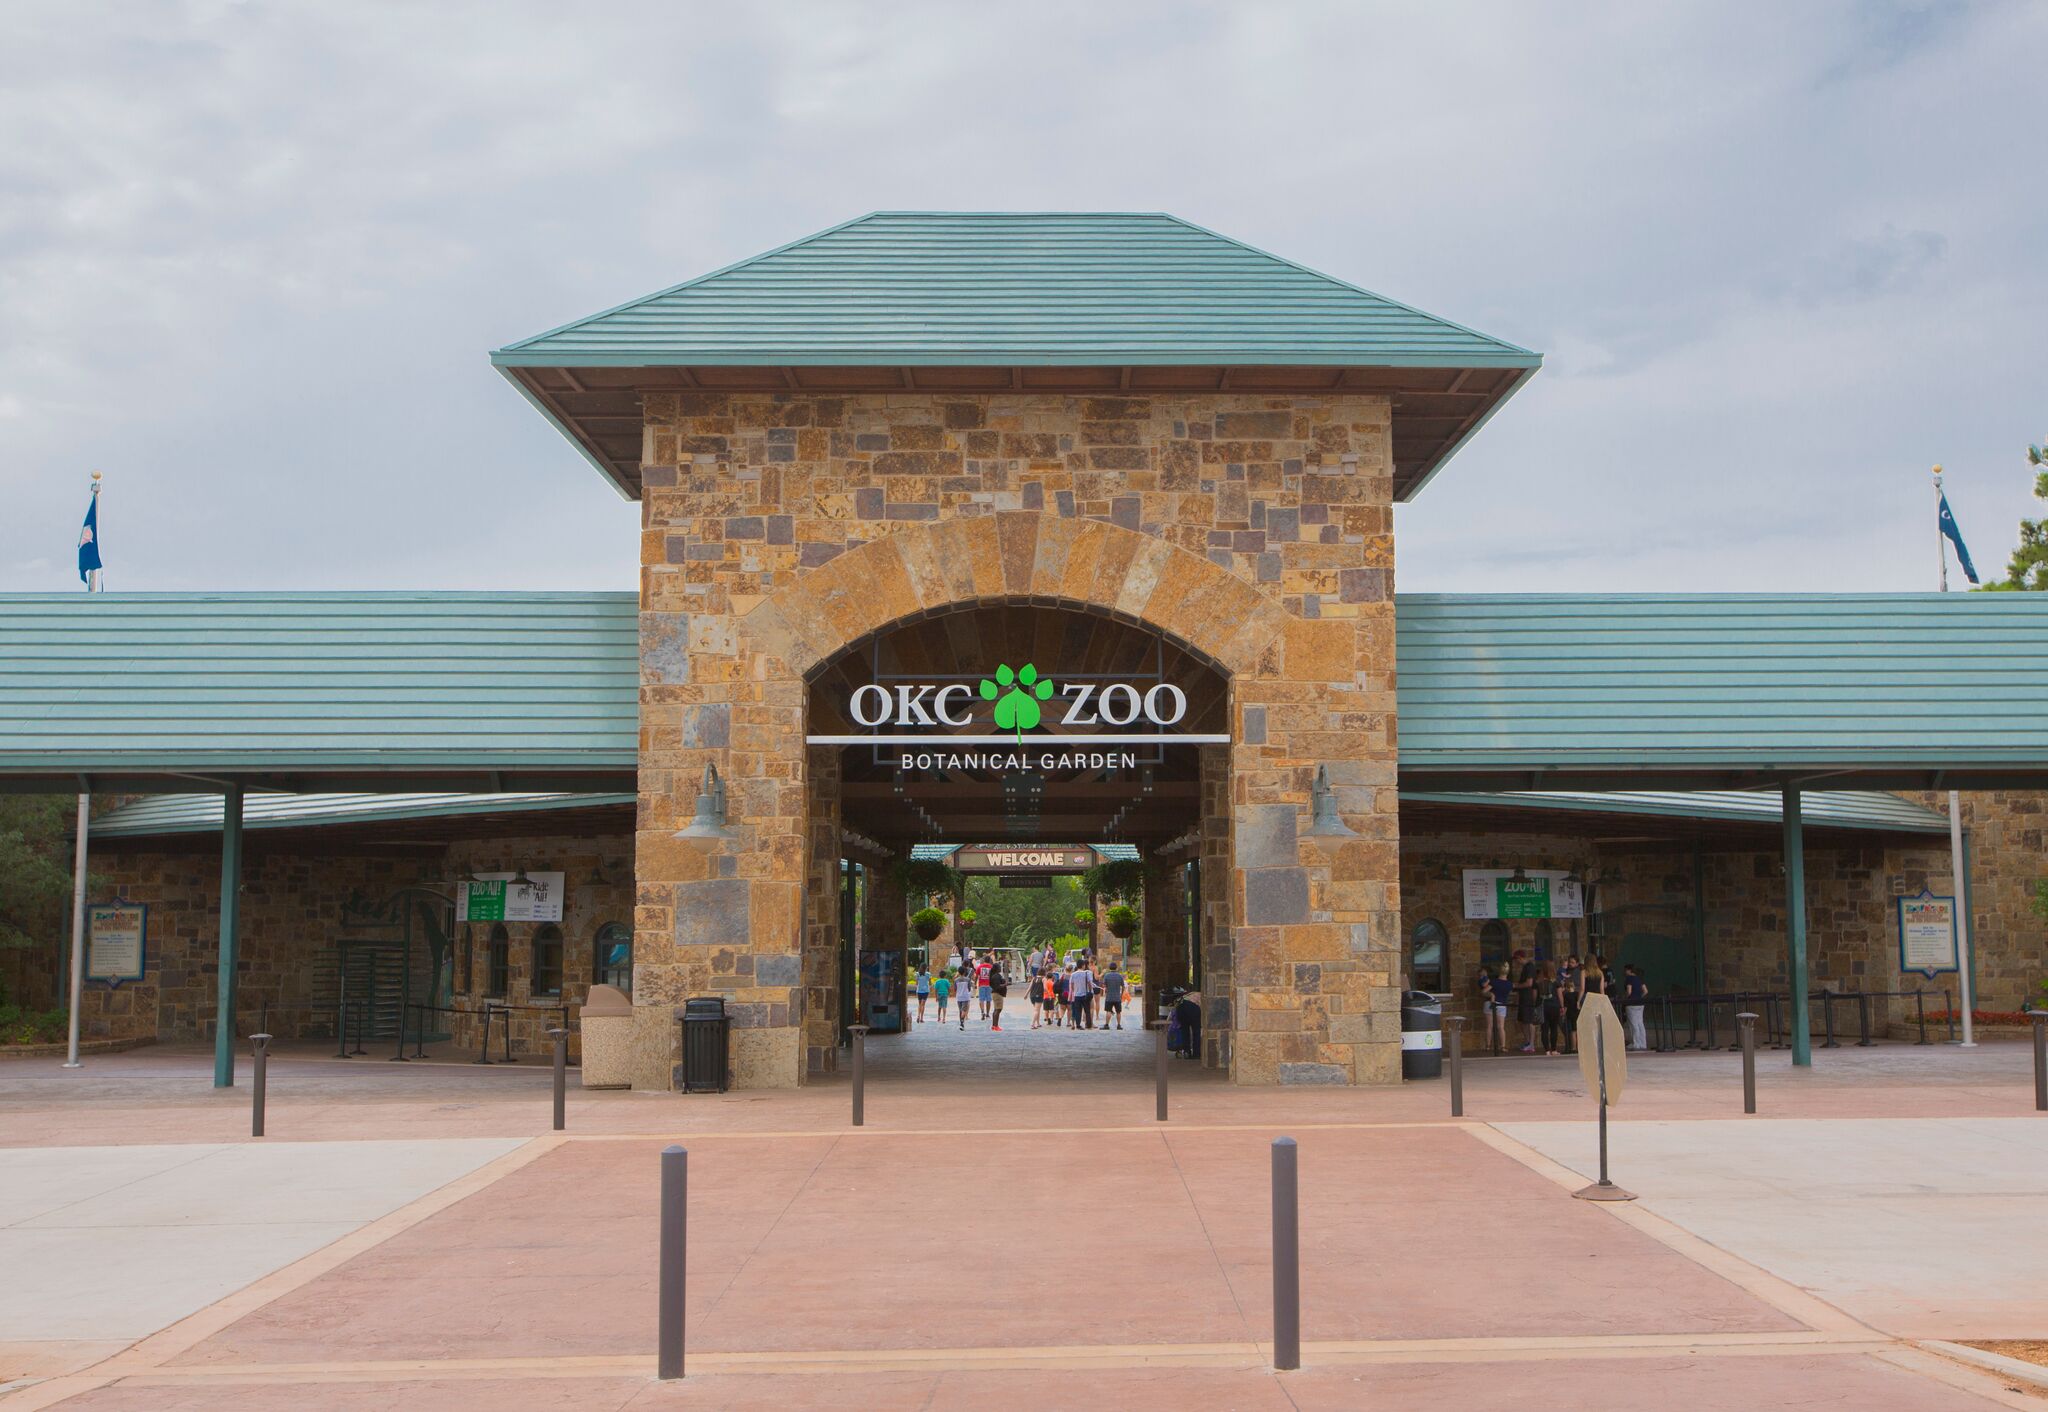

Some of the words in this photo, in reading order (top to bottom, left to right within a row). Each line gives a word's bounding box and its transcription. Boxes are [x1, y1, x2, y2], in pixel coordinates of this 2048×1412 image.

[850, 684, 973, 726] OKC
[1060, 683, 1187, 725] ZOO
[901, 753, 1033, 770] BOTANICAL
[1040, 753, 1136, 769] GARDEN
[986, 853, 1064, 866] WELCOME
